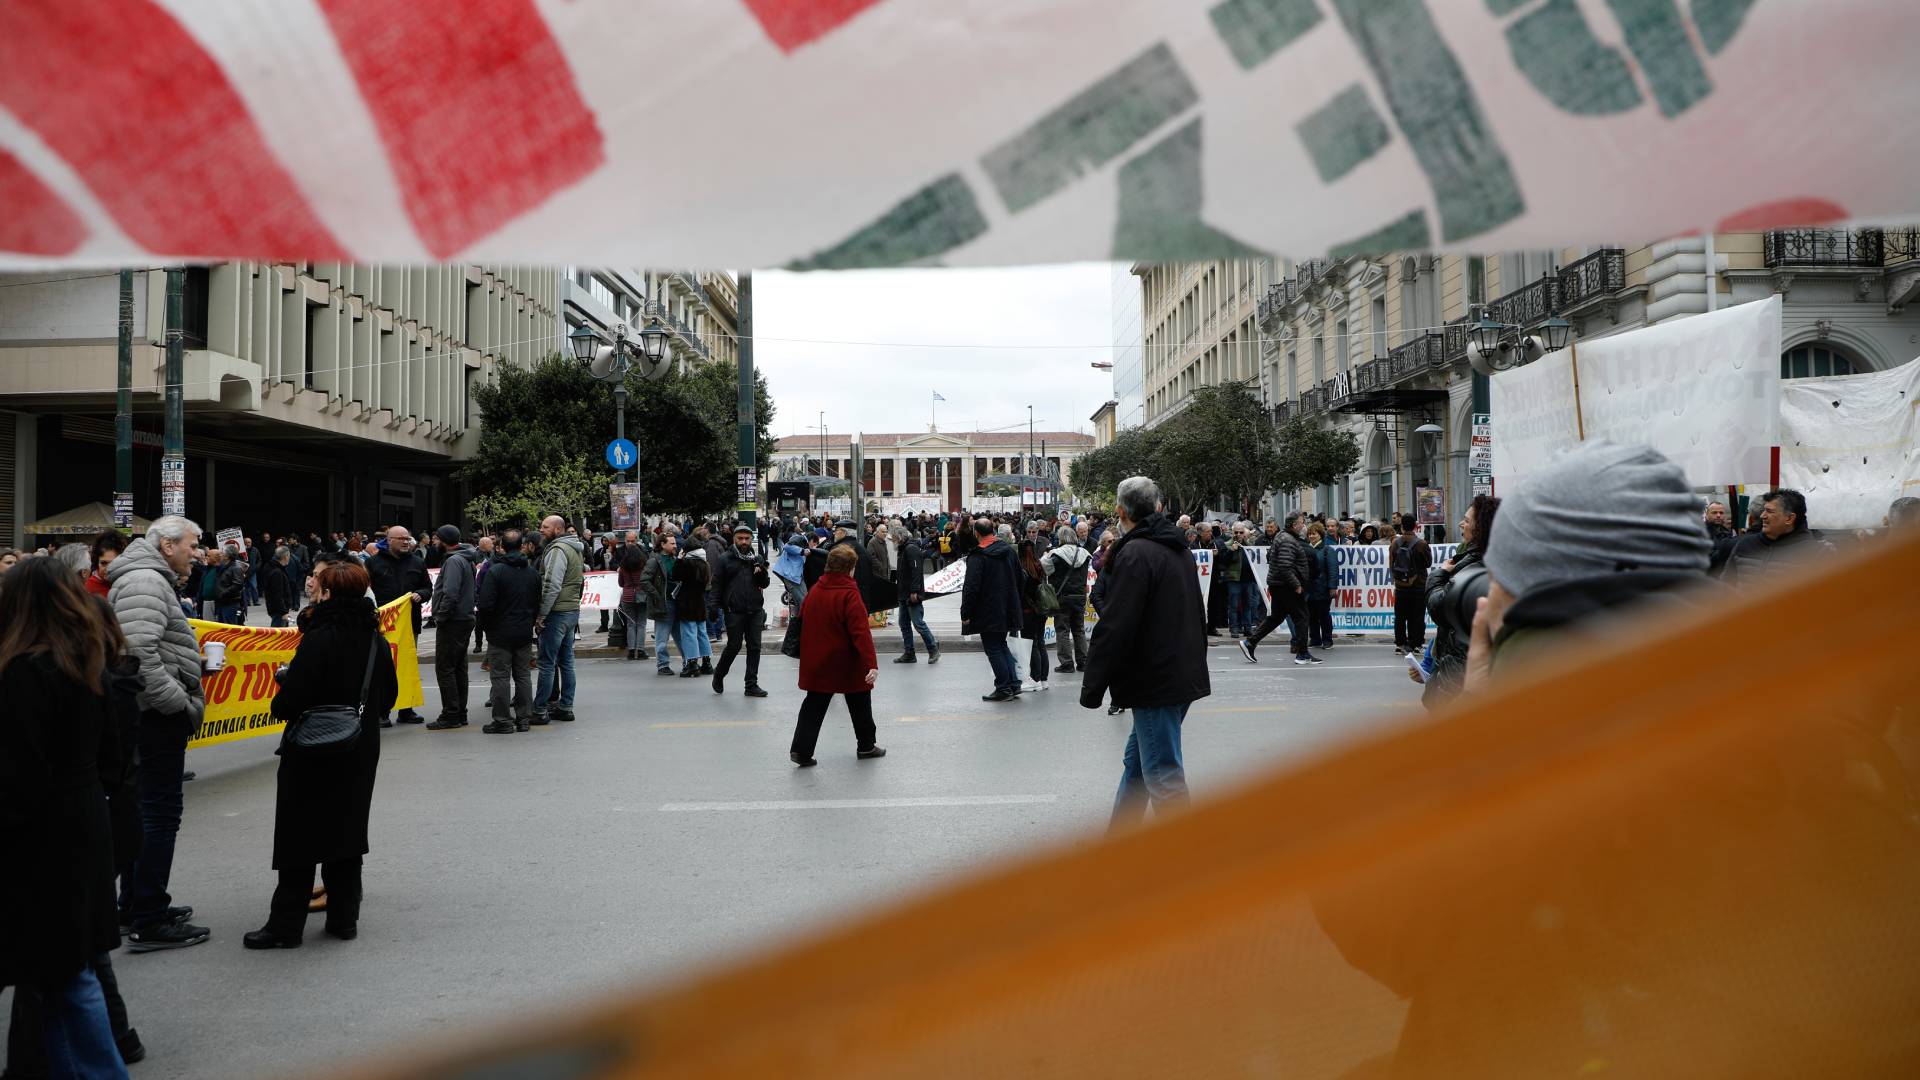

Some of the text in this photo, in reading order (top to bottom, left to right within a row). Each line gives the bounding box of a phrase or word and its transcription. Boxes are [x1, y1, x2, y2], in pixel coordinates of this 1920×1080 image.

[1332, 370, 1350, 400] ZARA
[1336, 547, 1384, 566] ΟΥΧΟΙ
[1363, 567, 1393, 586] ΥΠΑ
[1333, 588, 1396, 608] ΥΜΕ ΘΥΜ
[1332, 614, 1383, 627] ΝΤΑΞΙΟΥΧΩΝ
